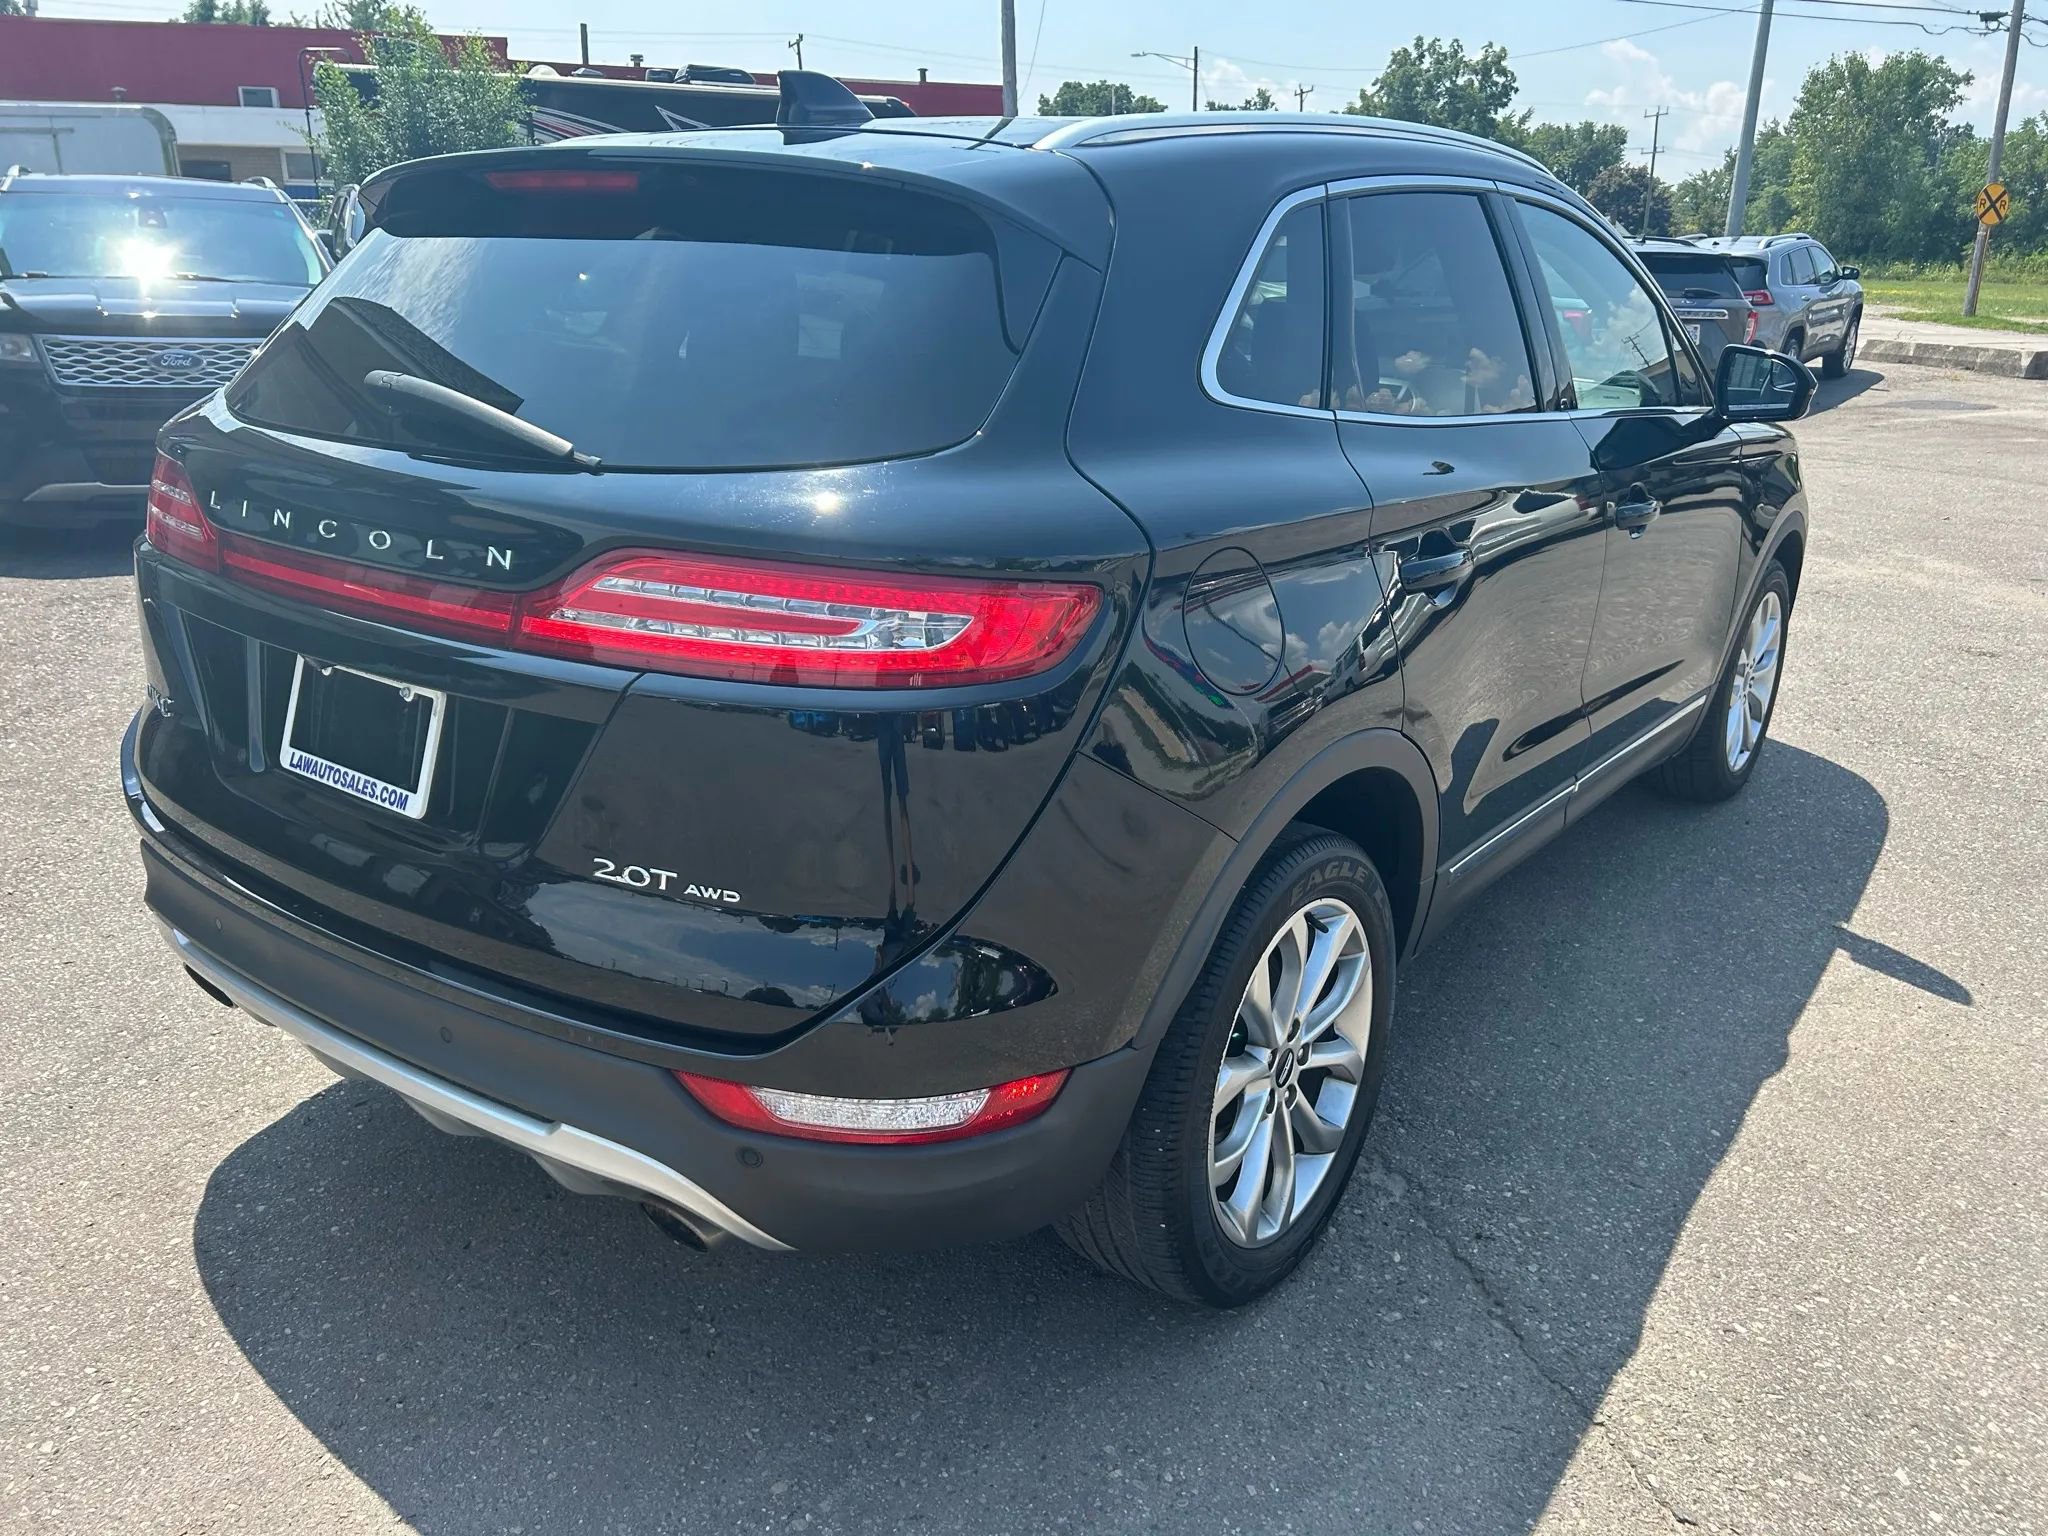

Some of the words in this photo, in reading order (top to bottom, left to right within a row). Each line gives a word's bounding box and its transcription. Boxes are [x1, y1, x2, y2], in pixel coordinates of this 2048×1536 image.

[1979, 198, 1987, 209] R
[1999, 199, 2007, 210] R
[160, 353, 192, 366] Ford
[209, 490, 512, 571] LINCOLN
[288, 751, 409, 811] LAWAUTOSALES.COM
[683, 884, 741, 903] AWD
[1289, 860, 1369, 907] EAGLE
